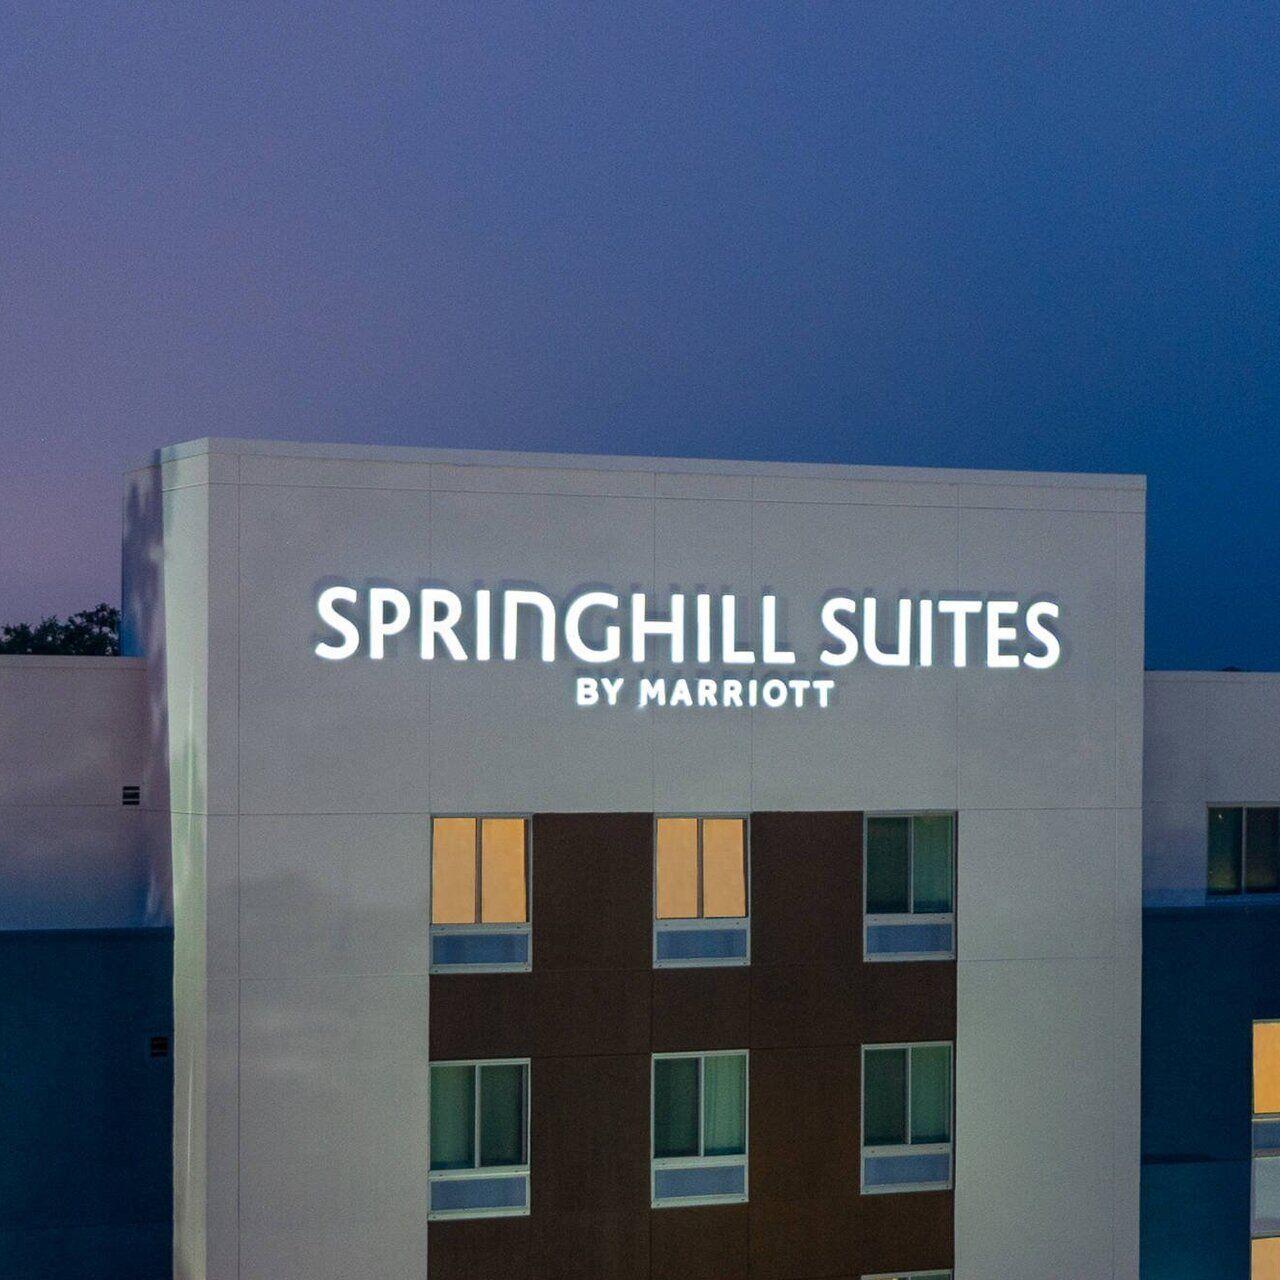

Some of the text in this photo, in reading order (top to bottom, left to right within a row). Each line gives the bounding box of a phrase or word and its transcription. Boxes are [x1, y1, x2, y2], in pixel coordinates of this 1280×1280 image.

[314, 585, 1061, 670] SPRINGHILL SUITES
[576, 676, 836, 709] BY MARRIOTT
